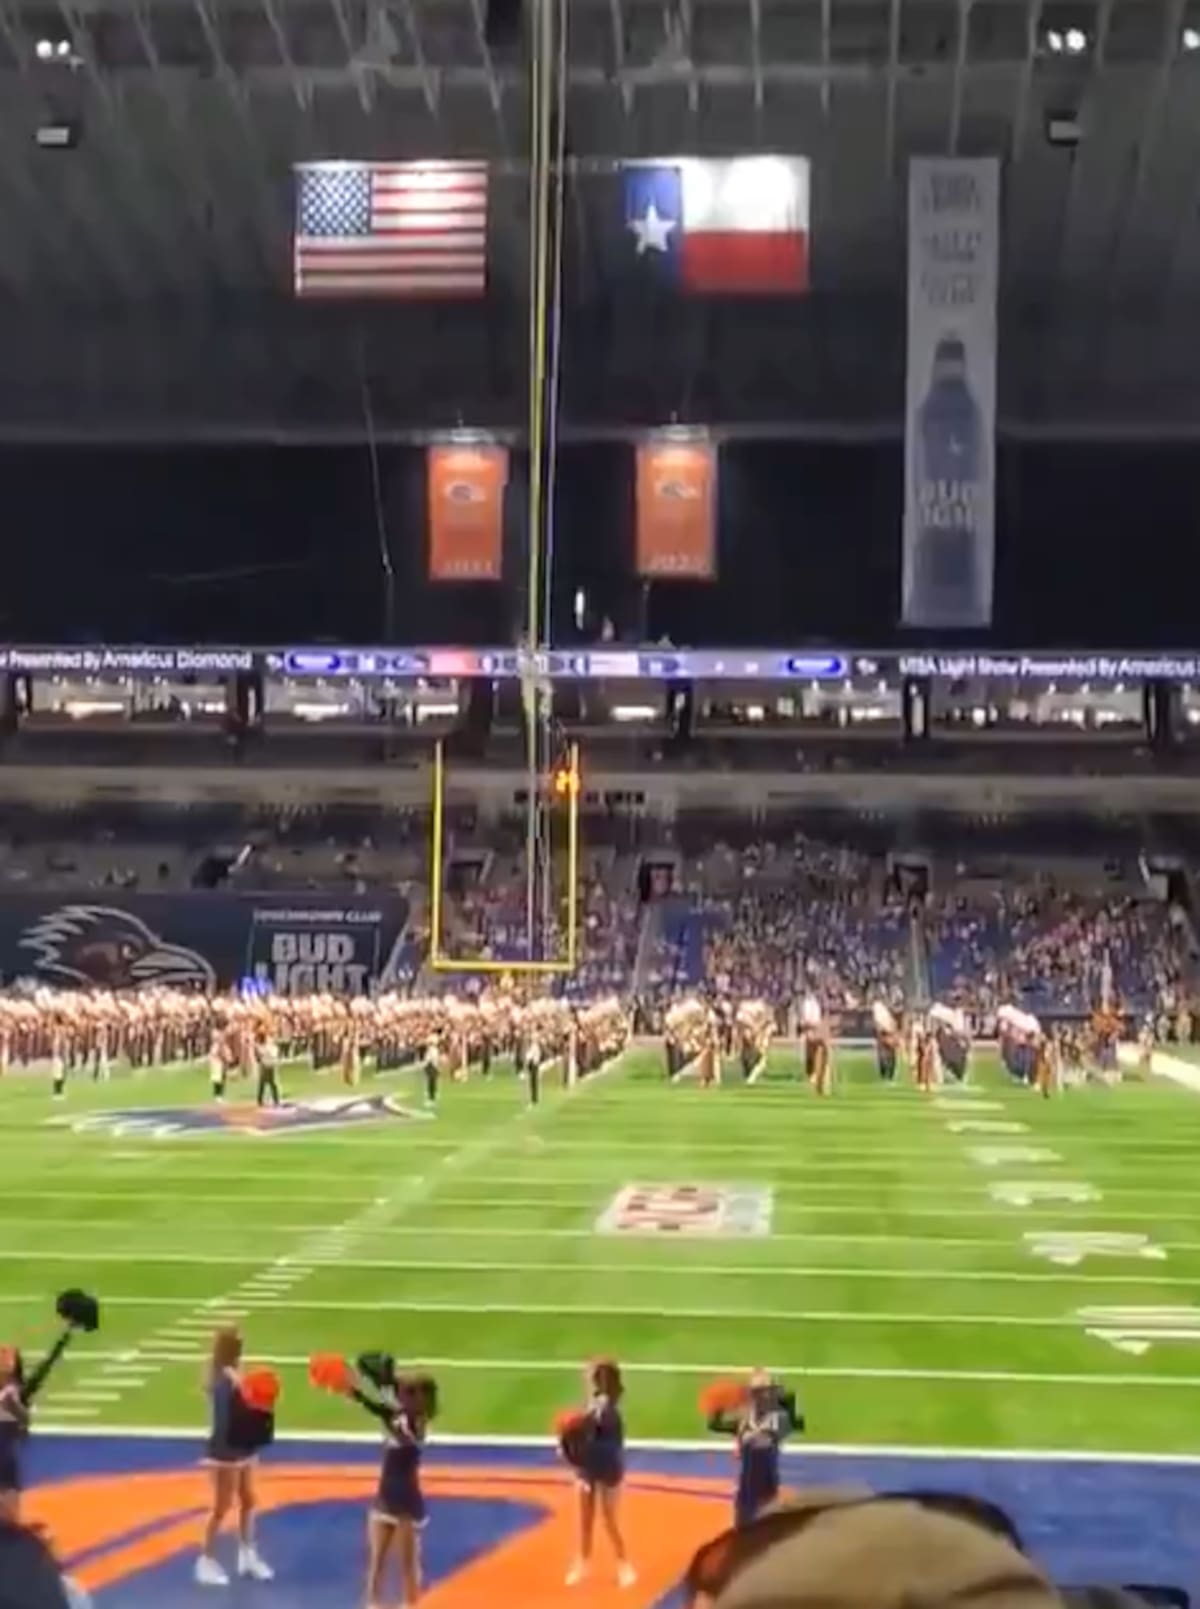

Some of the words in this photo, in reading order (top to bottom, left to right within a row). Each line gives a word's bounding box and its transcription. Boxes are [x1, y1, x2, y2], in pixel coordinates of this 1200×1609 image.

[9, 651, 80, 669] Presented
[83, 651, 100, 671] By
[177, 650, 251, 669] Diamond
[272, 933, 353, 963] BUD
